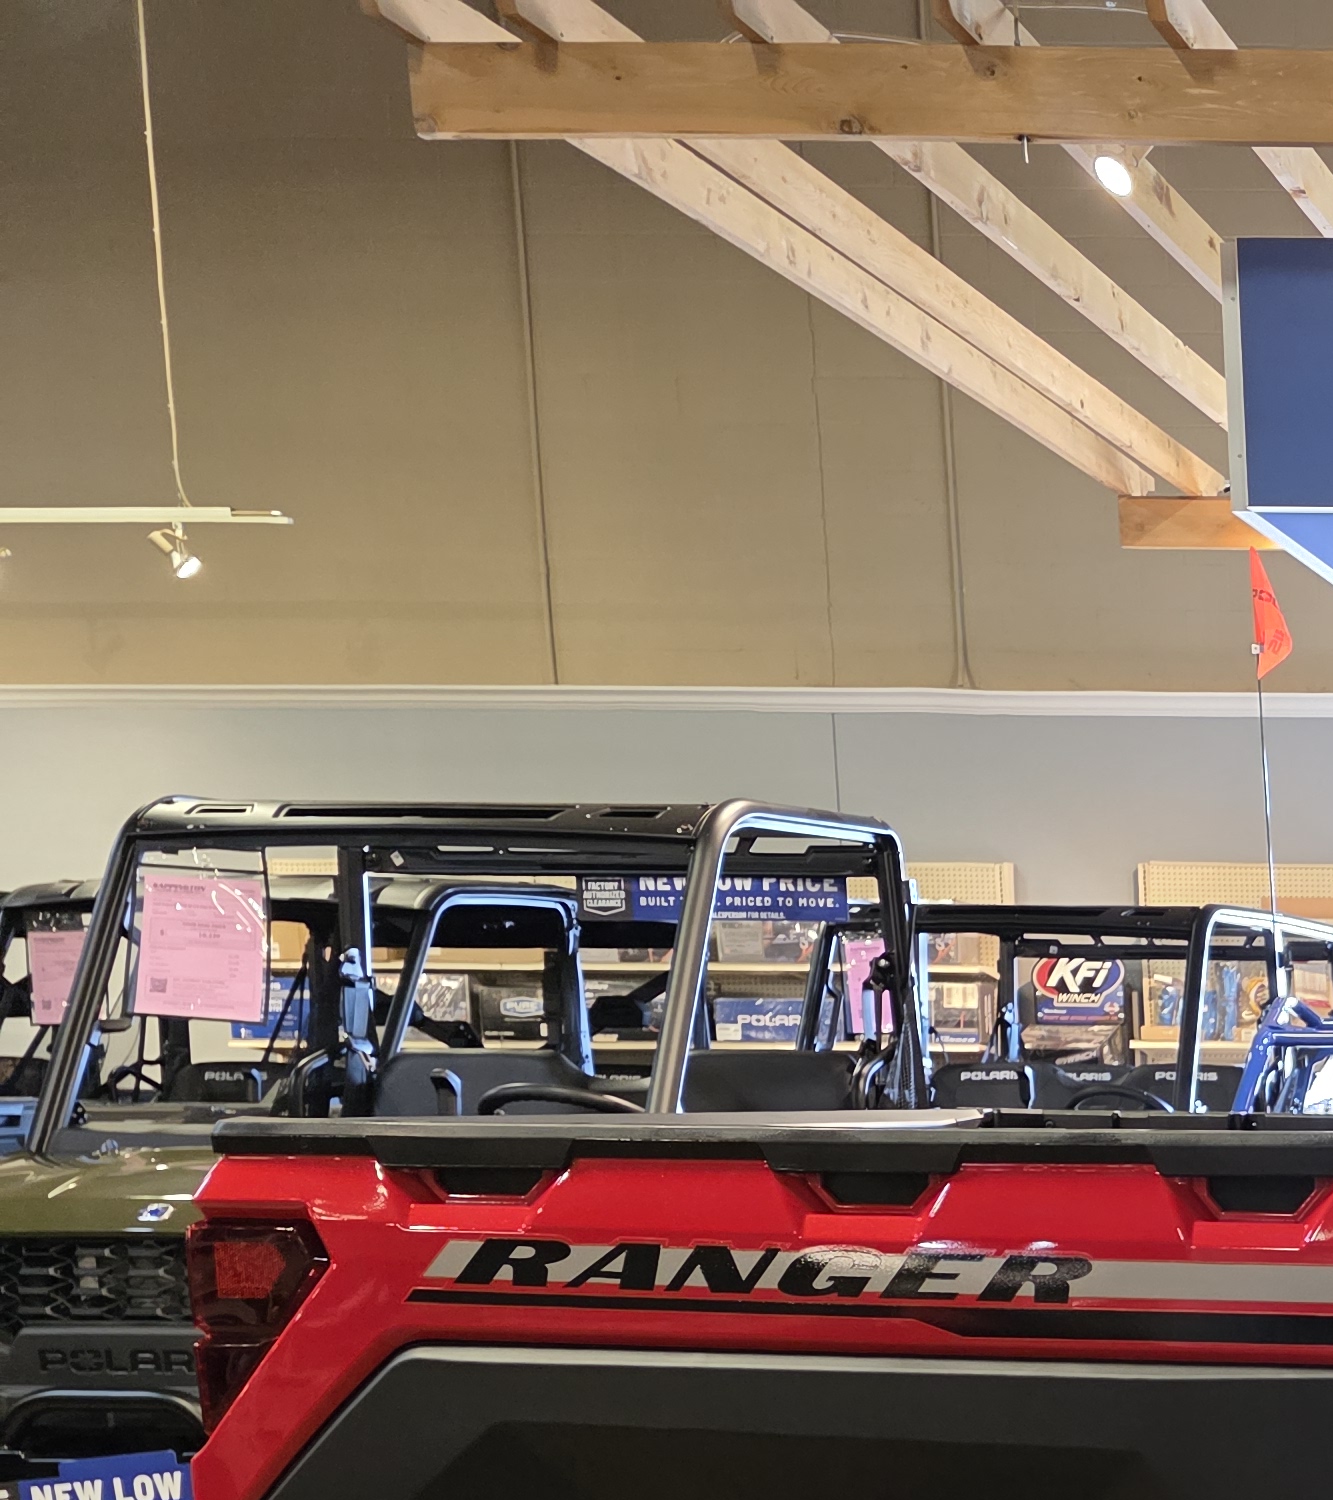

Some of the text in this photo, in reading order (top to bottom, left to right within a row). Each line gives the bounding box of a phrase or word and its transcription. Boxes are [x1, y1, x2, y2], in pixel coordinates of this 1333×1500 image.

[718, 877, 752, 892] OW
[763, 877, 838, 893] PRICE
[639, 896, 840, 908] BUILT PRICED TO MOVE.
[1057, 993, 1102, 1003] WINCH
[737, 1014, 801, 1026] POLAR
[454, 1237, 1093, 1304] RANGER
[38, 1348, 198, 1376] POLAR
